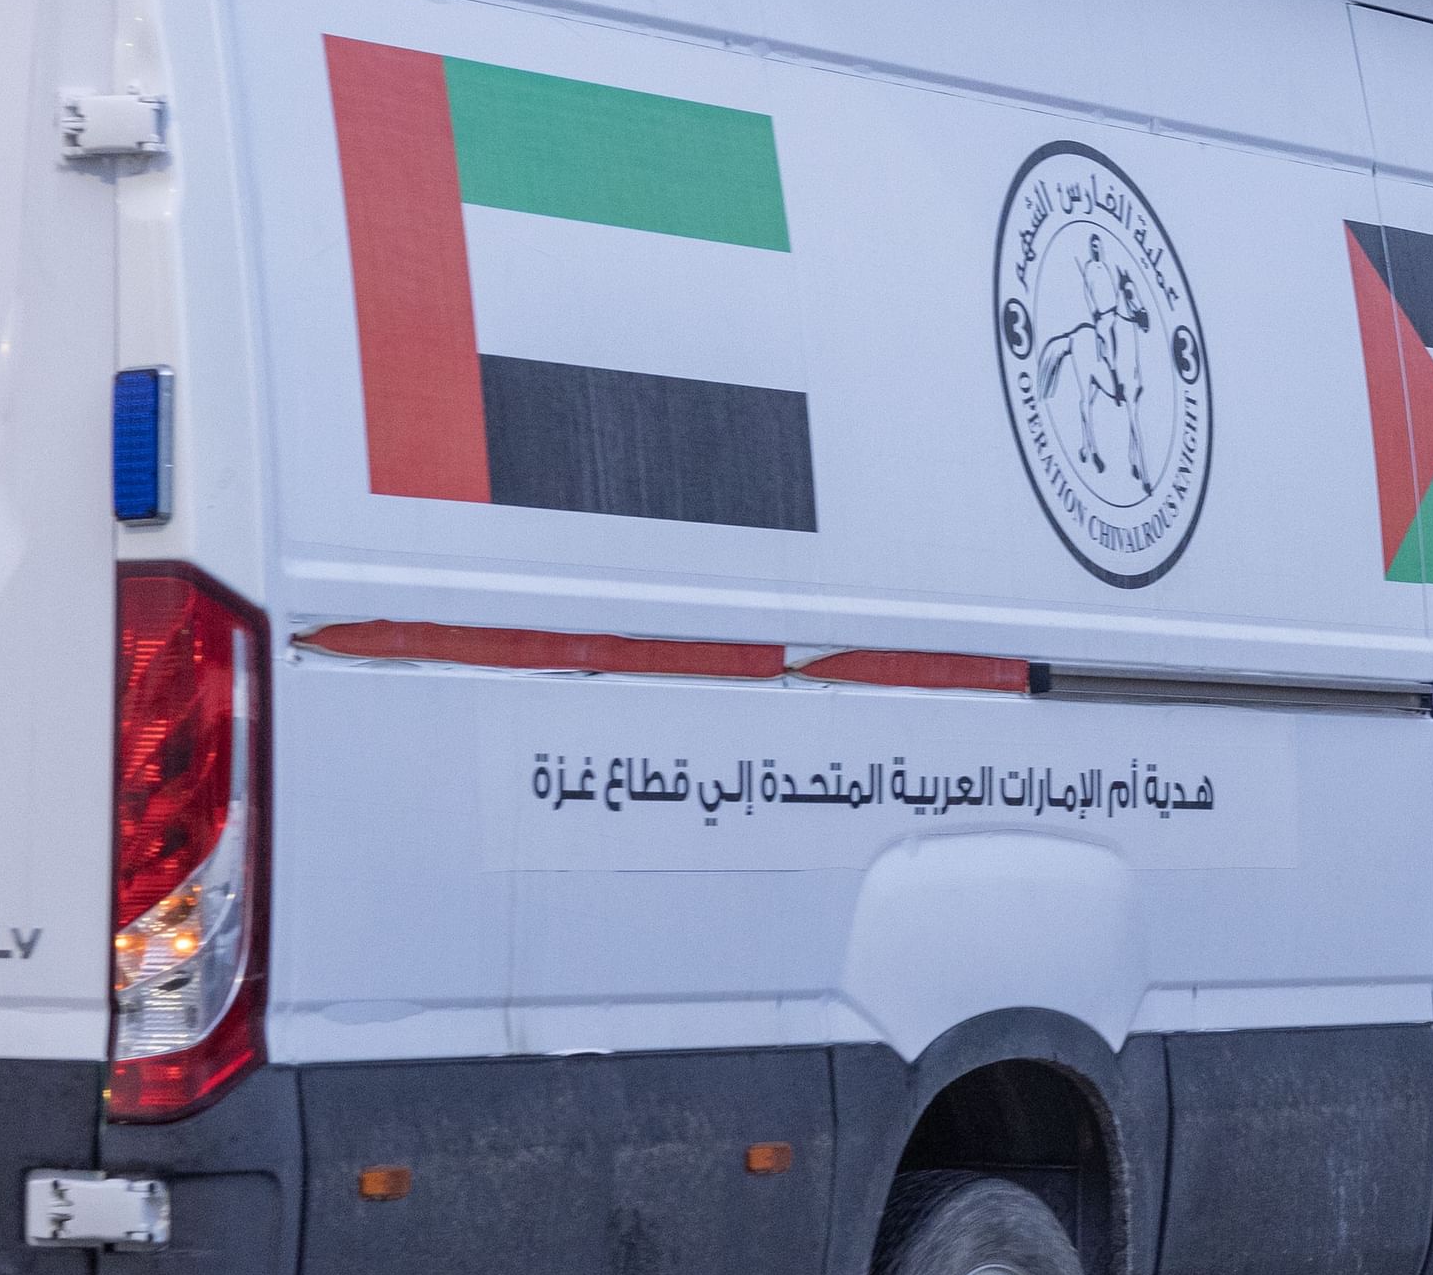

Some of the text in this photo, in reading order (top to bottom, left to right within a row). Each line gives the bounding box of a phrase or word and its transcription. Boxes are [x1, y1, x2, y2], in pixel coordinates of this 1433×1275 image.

[1015, 174, 1179, 312] عملية الفارس الشهم
[1018, 371, 1198, 553] OPERATION CHIVALROUS KNIGHT
[533, 753, 596, 810] غزة
[604, 758, 690, 812] قطاع
[761, 760, 883, 809] المتحدة
[890, 757, 994, 815] العربية
[1000, 767, 1102, 819] الإمارات
[1108, 759, 1138, 818] أم
[1144, 764, 1214, 819] هدية
